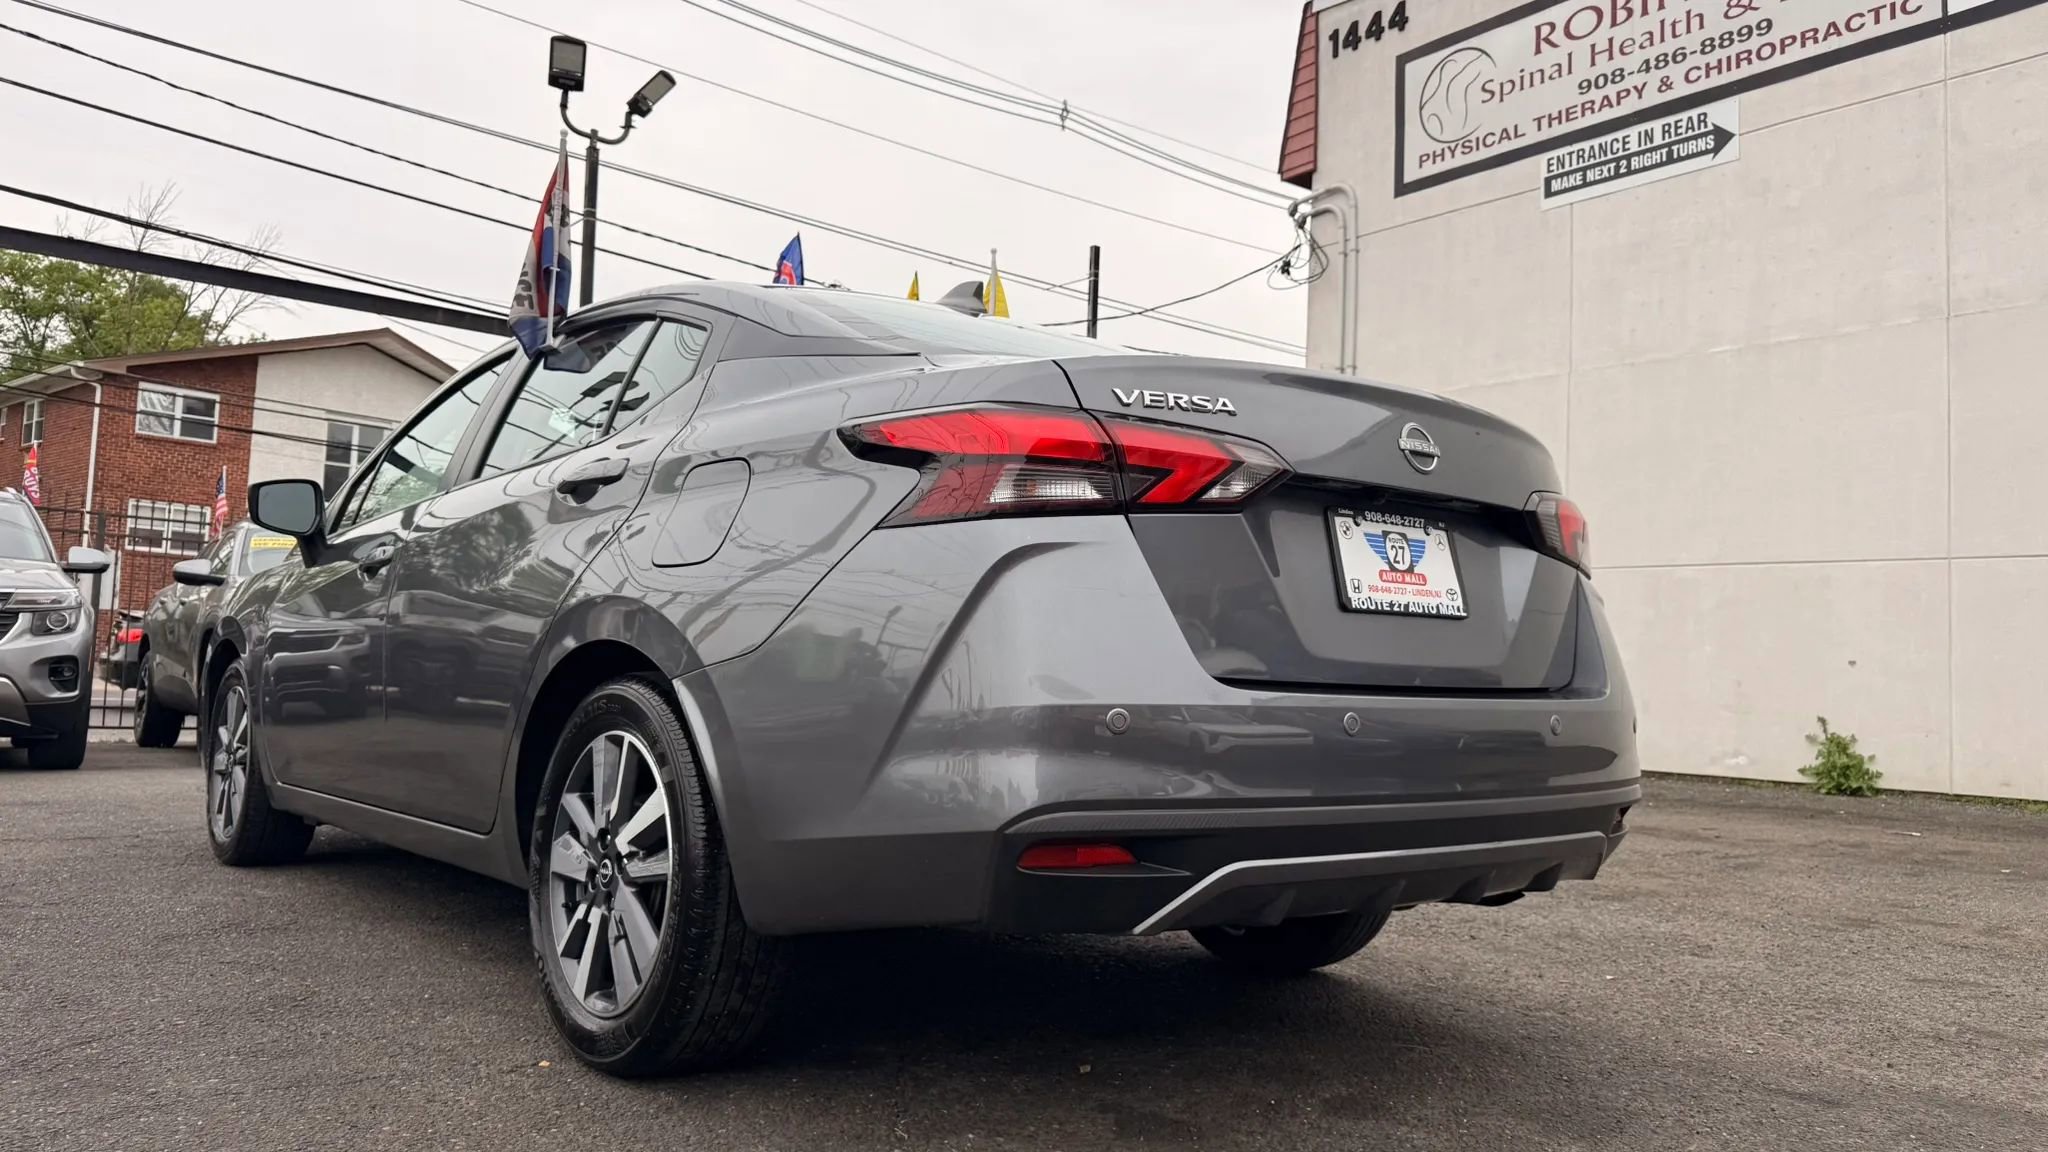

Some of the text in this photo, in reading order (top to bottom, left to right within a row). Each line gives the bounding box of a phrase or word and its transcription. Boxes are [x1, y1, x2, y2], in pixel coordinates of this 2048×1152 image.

[1328, 2, 1409, 58] 1444
[1480, 51, 1573, 104] Spinal
[1589, 8, 1705, 68] Health
[1577, 18, 1773, 96] 908-486-8899
[1418, 0, 1923, 169] PHYSICAL THERAPY & CHIROPRACTIC
[1546, 111, 1709, 174] ENTRANCE IN REAR
[1550, 135, 1715, 193] MAKE NEXT 2 RIGHT TURNS
[1111, 387, 1237, 416] VERSA
[1400, 439, 1440, 456] NISSAN
[1364, 511, 1425, 528] 908-648-2727
[1388, 536, 1405, 545] ROUTE
[1390, 545, 1405, 565] 27
[1381, 571, 1426, 585] AUTO MALL
[1351, 596, 1467, 616] ROUTE 27 AUTO MALL
